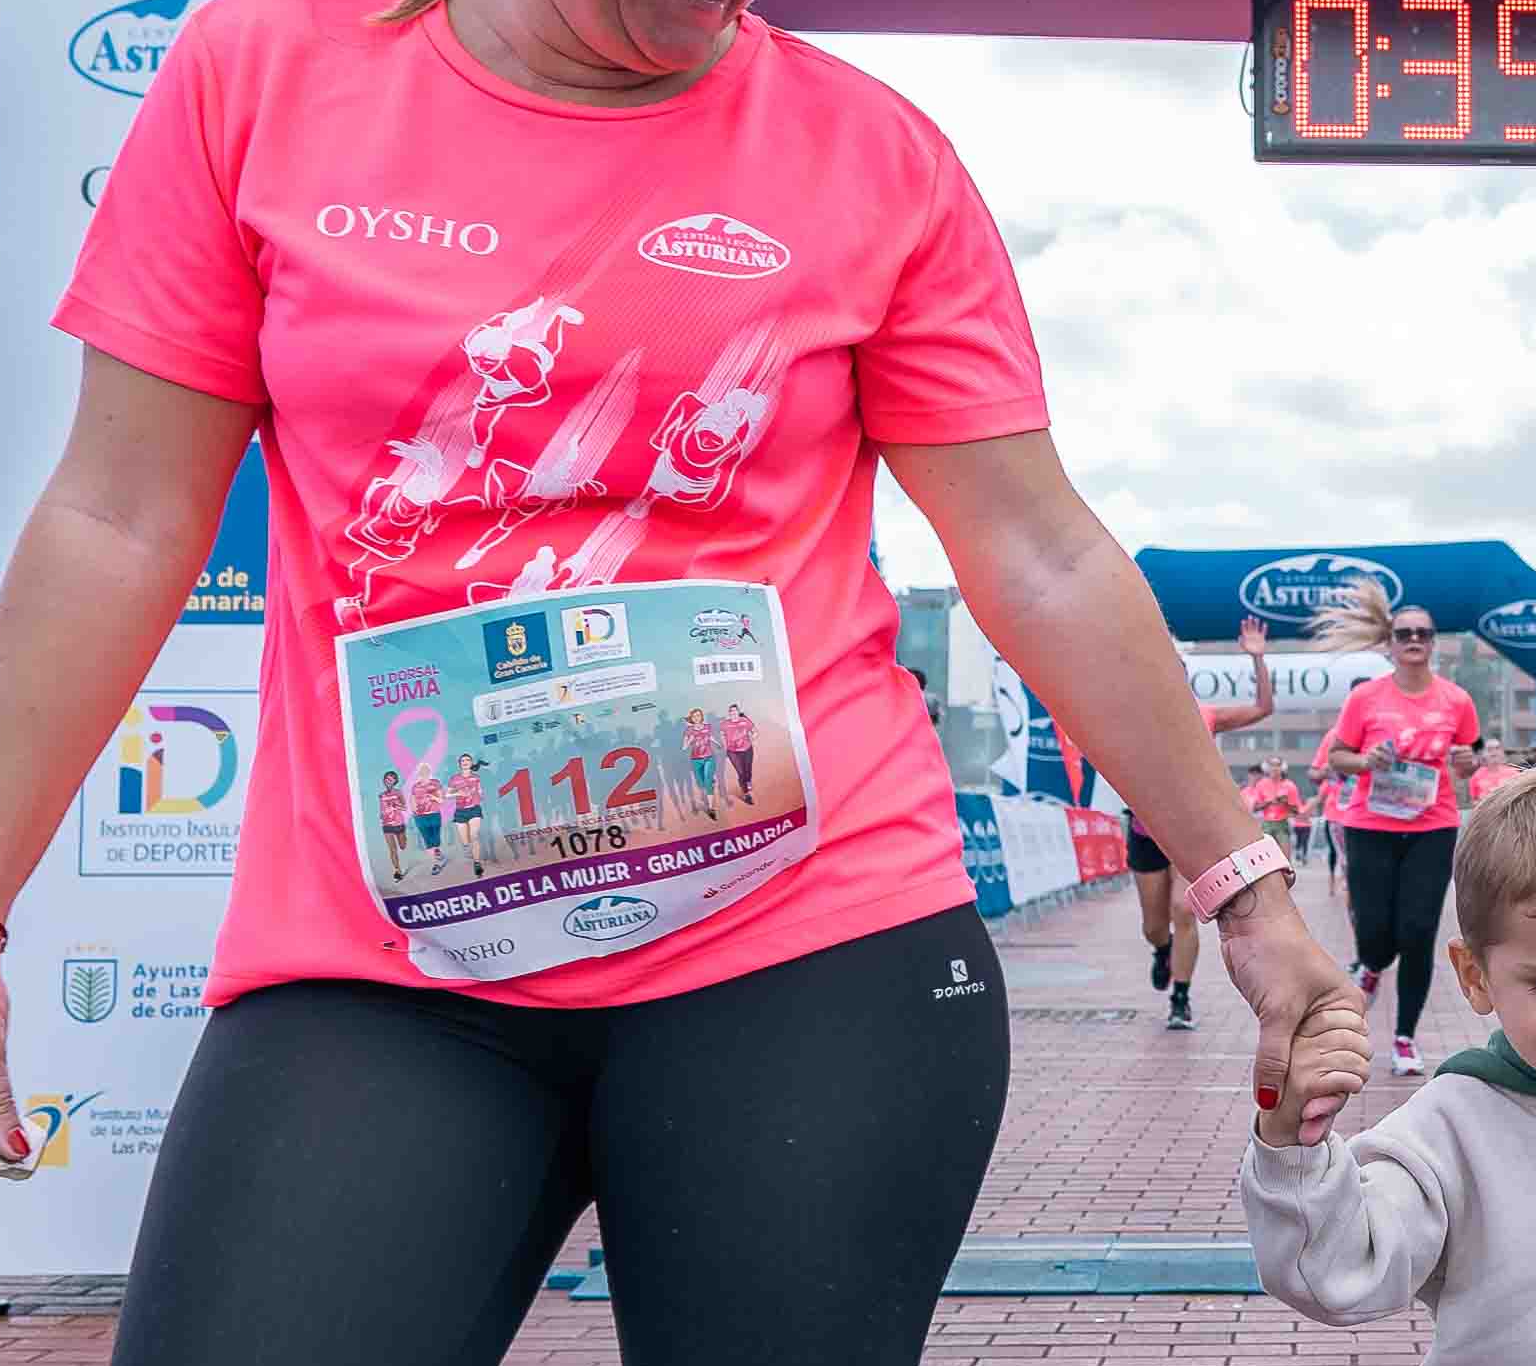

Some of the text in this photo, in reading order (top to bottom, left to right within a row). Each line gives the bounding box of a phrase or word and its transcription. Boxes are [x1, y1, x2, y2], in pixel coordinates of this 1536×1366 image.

[316, 203, 500, 257] OYSHO
[648, 234, 780, 268] ASTURIANA
[185, 590, 264, 612] anaria
[370, 678, 441, 709] SUMA
[1191, 667, 1330, 699] OYHO
[497, 746, 658, 827] 112
[550, 824, 626, 859] 1078
[398, 818, 795, 925] CARRERA DE LA MUJER GRAN CANARIA
[571, 910, 655, 934] ASTURIANA
[132, 982, 202, 999] de Las
[933, 981, 986, 1000] DOMYOS
[131, 1001, 157, 1019] de
